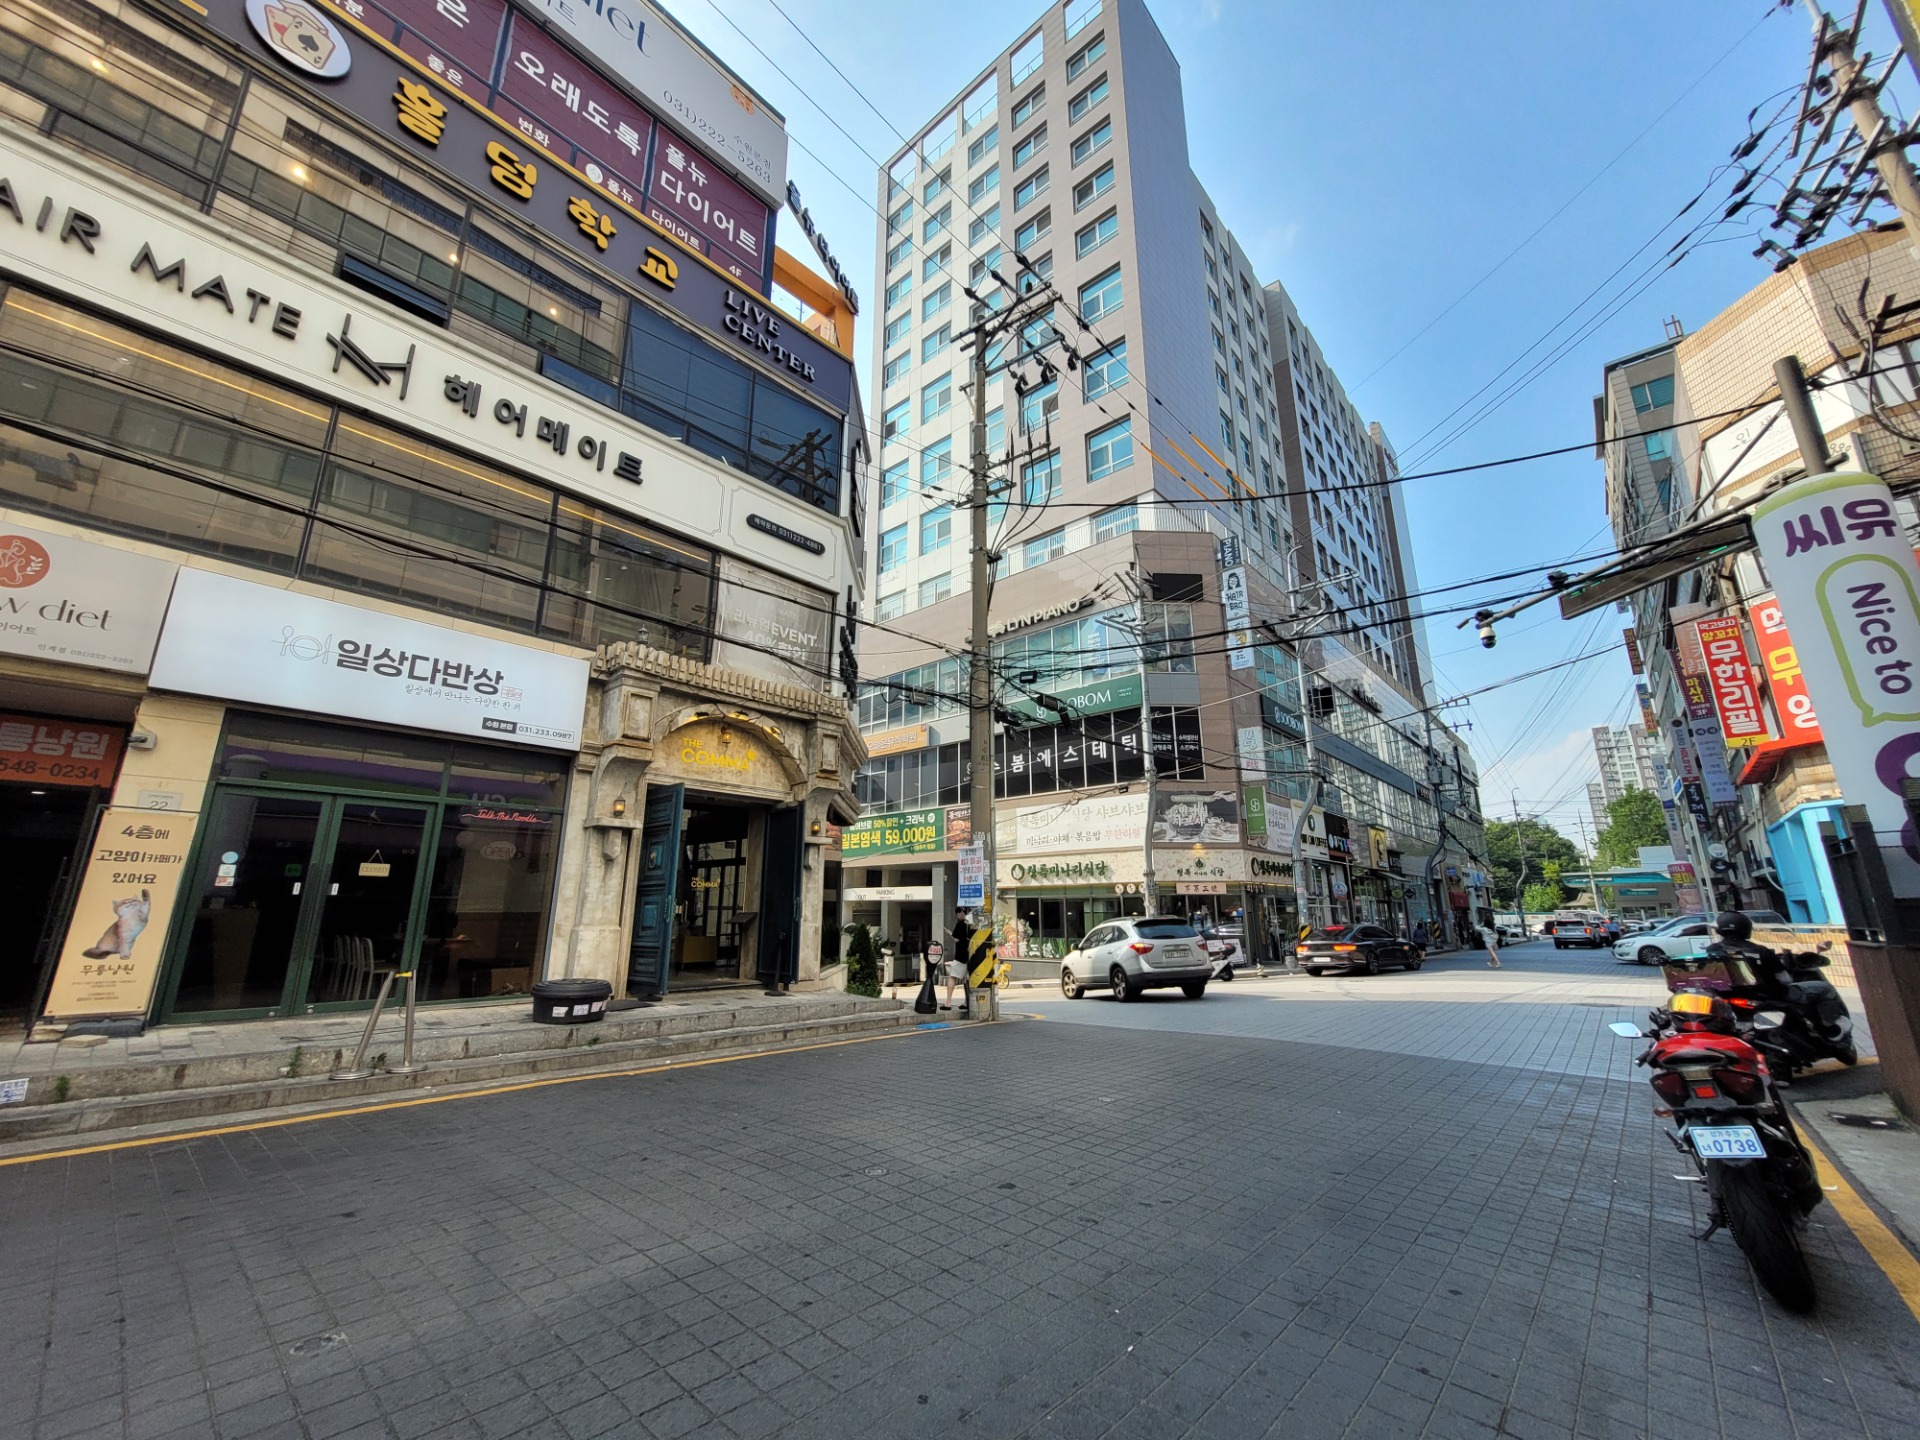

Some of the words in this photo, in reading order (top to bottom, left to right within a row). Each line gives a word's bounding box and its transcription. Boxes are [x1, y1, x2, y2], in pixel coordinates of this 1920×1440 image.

[514, 51, 641, 157] 오래도록
[663, 90, 772, 184] 031)222-5263
[427, 53, 464, 87] 좋은
[518, 116, 550, 148] 변화
[606, 178, 634, 204] 폴뉴
[651, 208, 700, 250] 다이어트
[729, 265, 742, 278] 4F
[665, 142, 708, 188] 폴뉴
[392, 76, 679, 289] 홀덤학교
[660, 170, 758, 257] 다이어트
[130, 241, 302, 340] MATE
[723, 289, 781, 337] LIVE
[723, 313, 817, 383] CENTER
[444, 373, 644, 486] 헤어메이트
[1782, 498, 1897, 558] 씨유
[1222, 538, 1235, 567] PIANO
[38, 599, 113, 632] diet
[1006, 612, 1033, 632] LYN
[1033, 599, 1080, 624] PIANO
[1699, 618, 1736, 630] 먹고보자
[1701, 627, 1739, 642] 양꼬치
[1846, 582, 1898, 655] Nice
[1875, 659, 1913, 695] to
[336, 639, 504, 696] 일상다반상
[405, 683, 442, 698] 일상에서
[443, 689, 472, 704] 만나는
[1685, 677, 1705, 704] 마사지
[1709, 639, 1762, 735] 무한리필
[518, 725, 572, 740] 031.233.0987
[682, 737, 703, 749] THE
[1741, 737, 1757, 747] 2F
[680, 748, 750, 772] COMMA
[120, 824, 170, 840] 4층에
[885, 825, 936, 846] 59,000원
[111, 871, 158, 885] 있어요
[361, 865, 389, 874] CLOSED
[690, 880, 719, 888] COMMA
